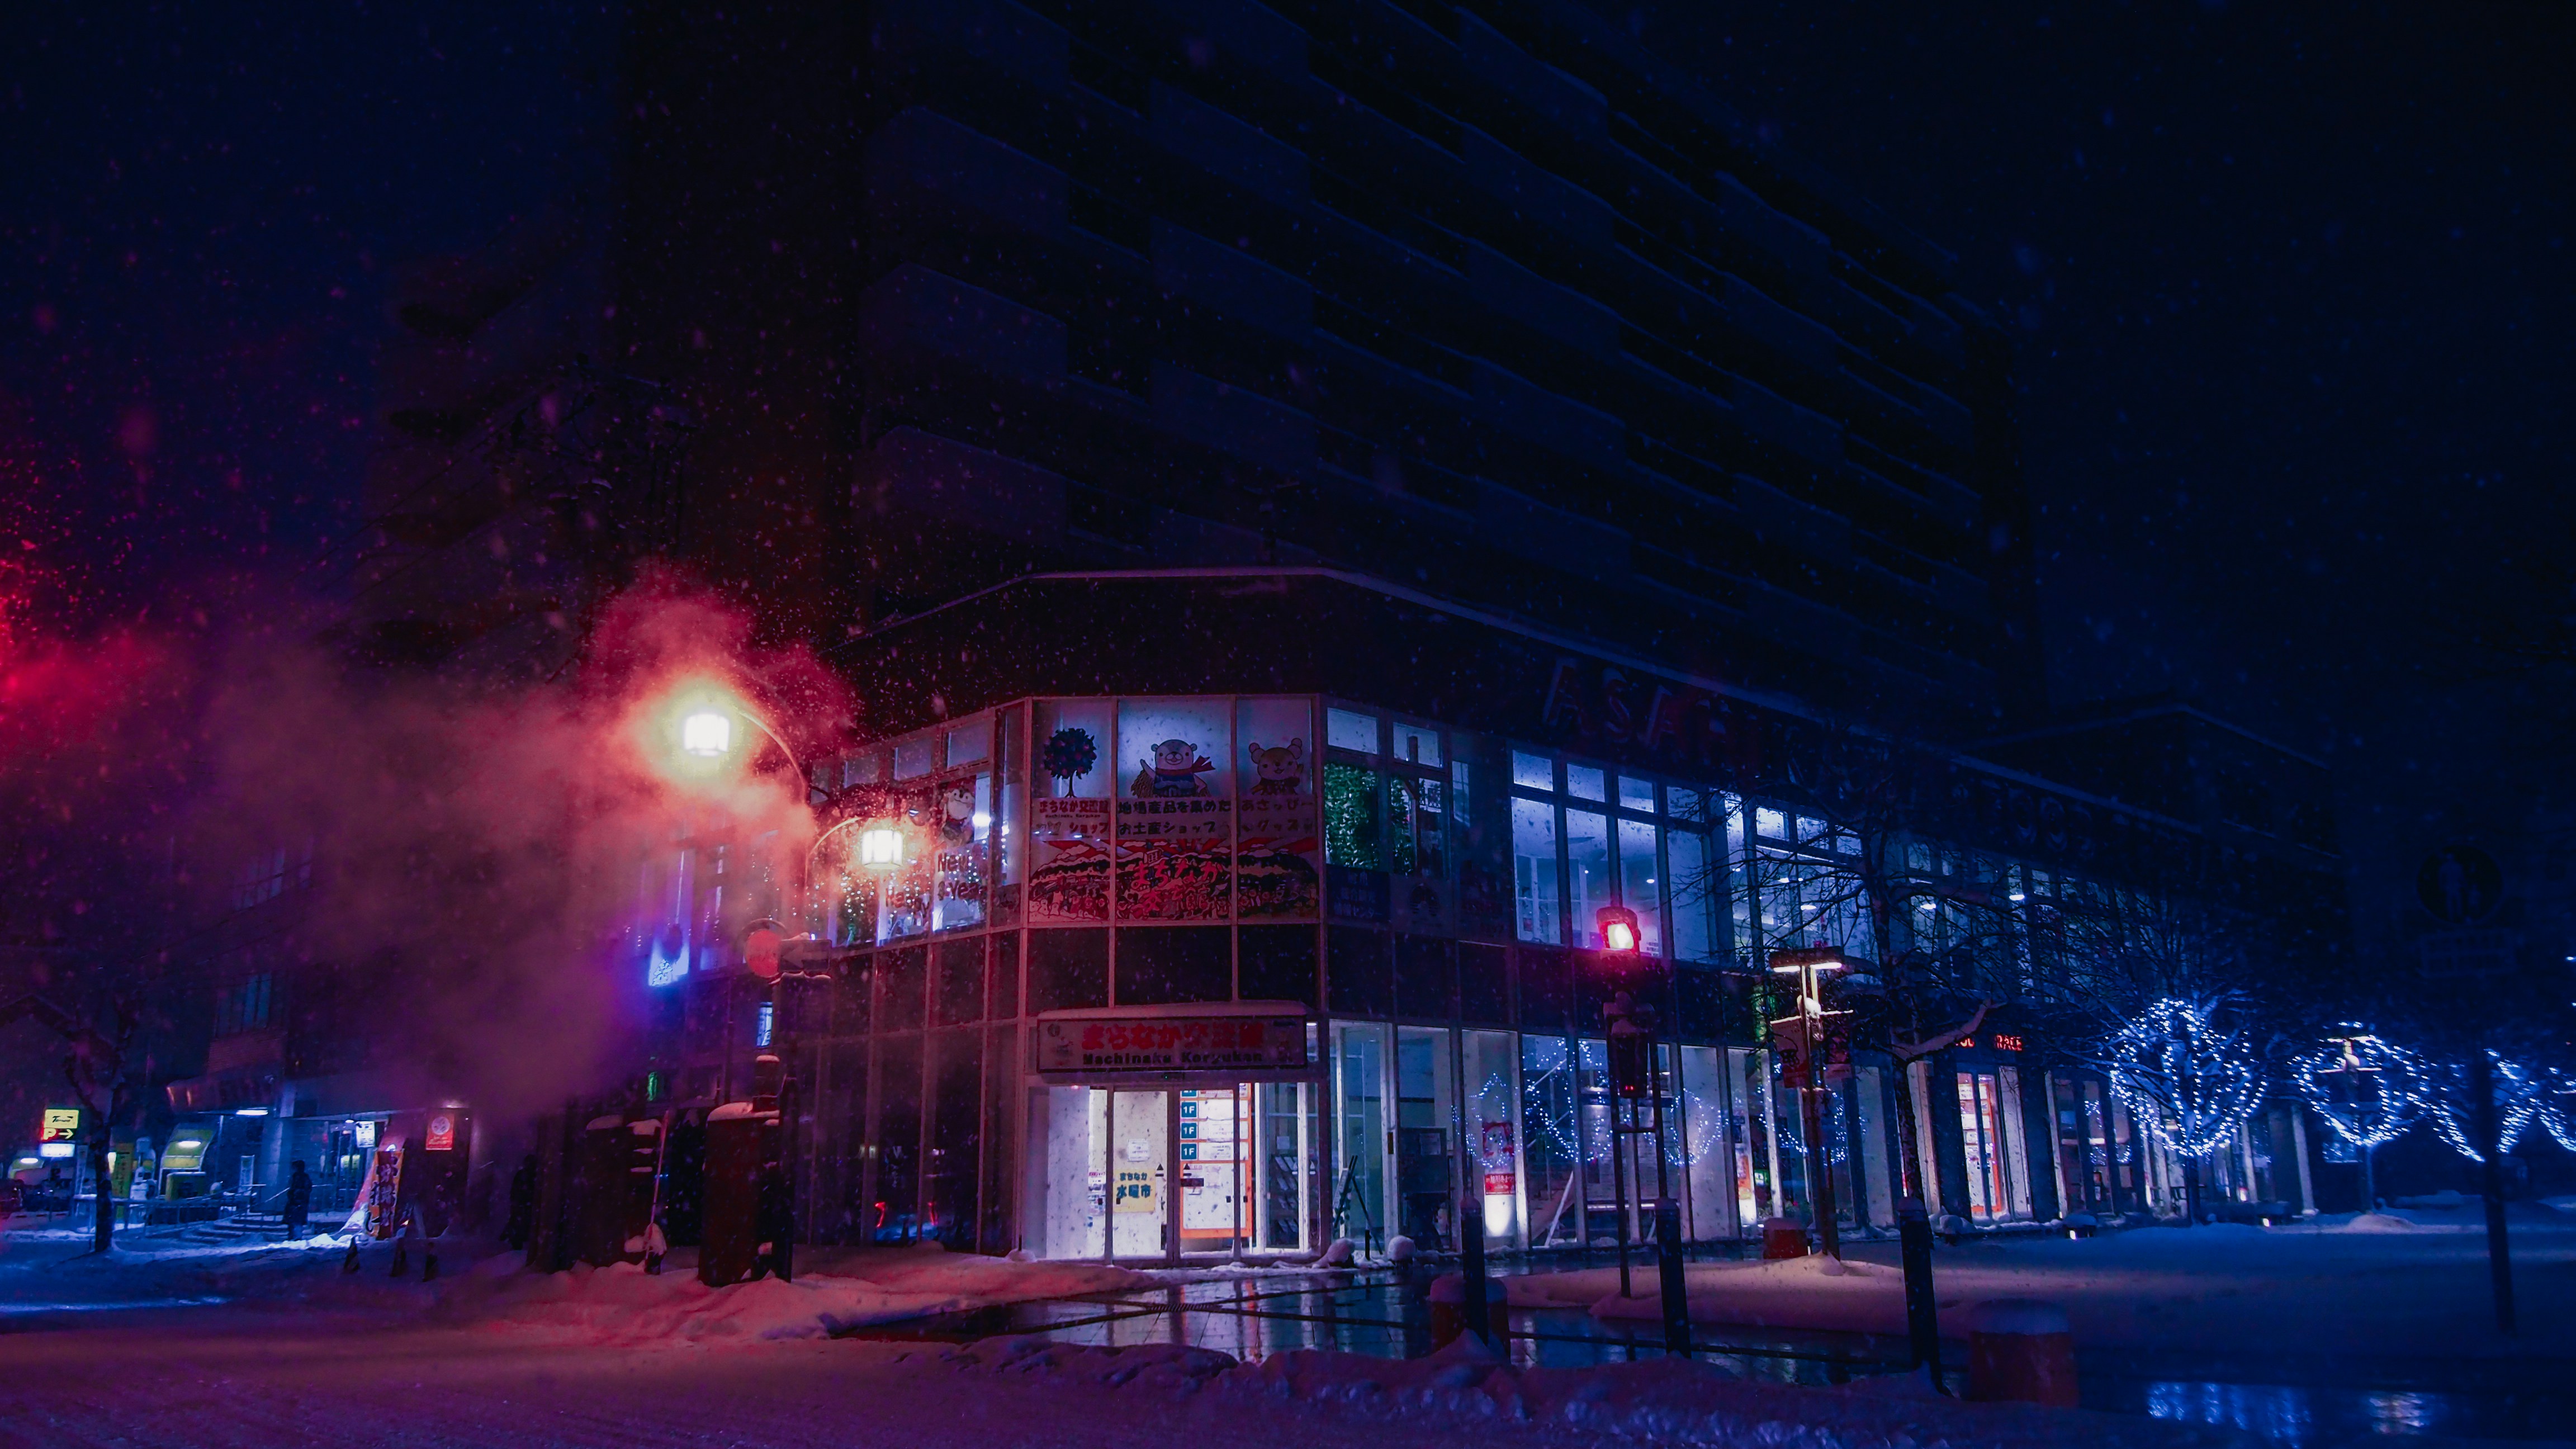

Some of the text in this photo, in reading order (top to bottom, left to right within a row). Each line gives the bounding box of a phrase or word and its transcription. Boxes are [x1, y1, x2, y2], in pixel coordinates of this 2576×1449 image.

[1119, 821, 1216, 835] お土産ショップ
[1130, 858, 1223, 890] まちなか
[1083, 1052, 1262, 1065] Machinaka Koryukan
[43, 1128, 57, 1140] P
[1183, 1126, 1195, 1135] 1F
